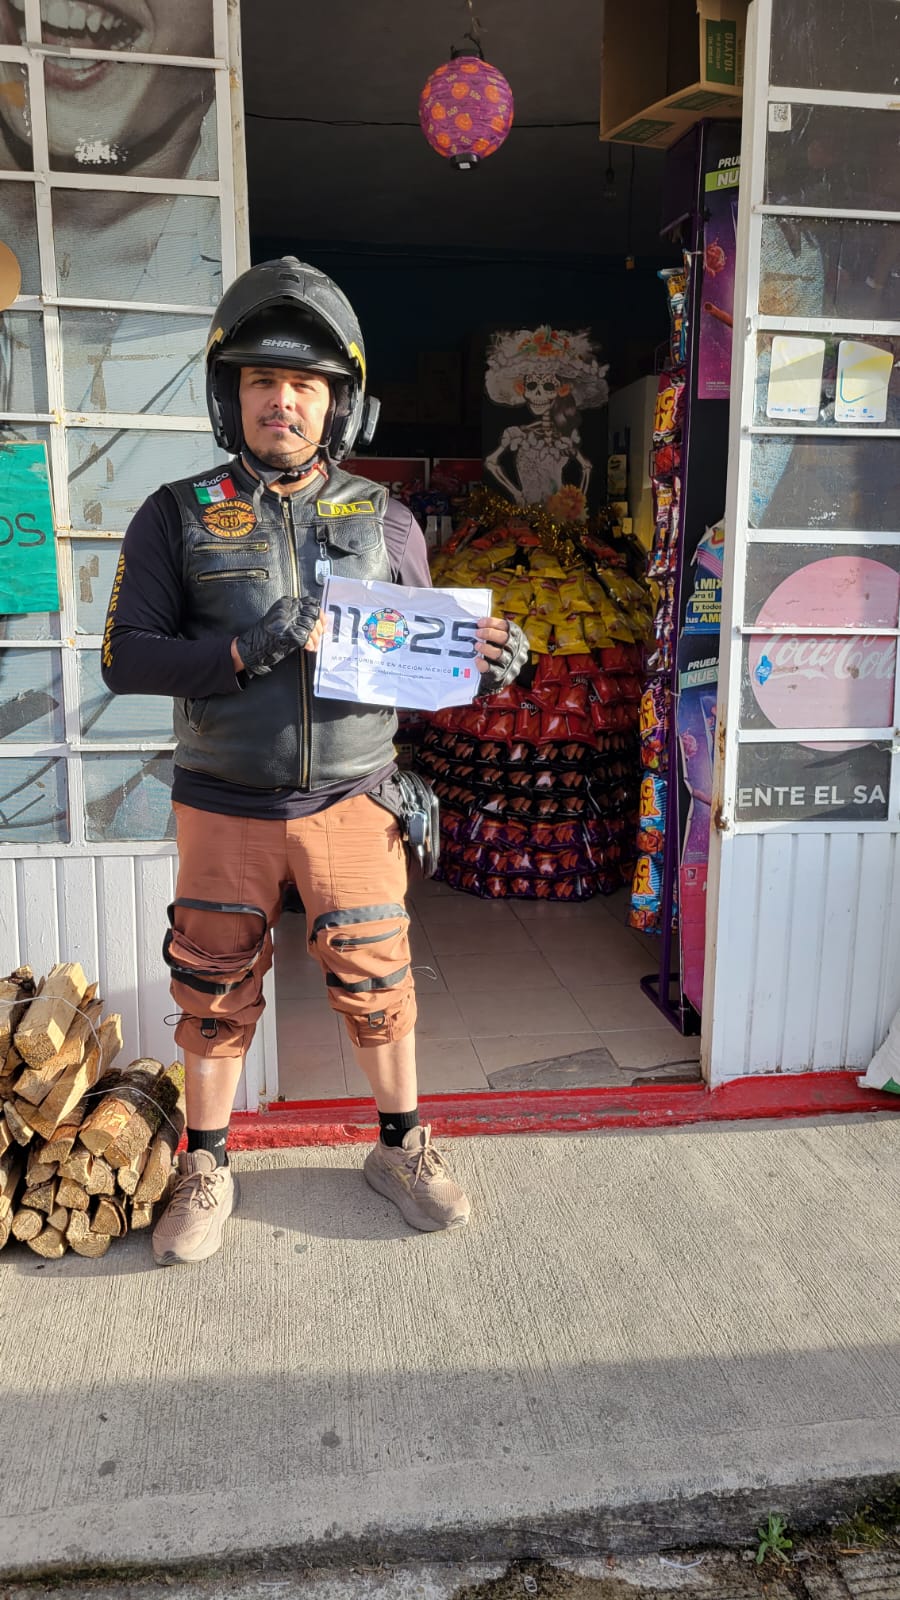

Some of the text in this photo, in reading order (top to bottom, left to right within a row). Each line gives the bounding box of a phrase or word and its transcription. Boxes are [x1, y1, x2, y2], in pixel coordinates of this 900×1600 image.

[261, 338, 312, 351] SHAFT
[410, 614, 478, 659] 25
[814, 785, 845, 805] EL
